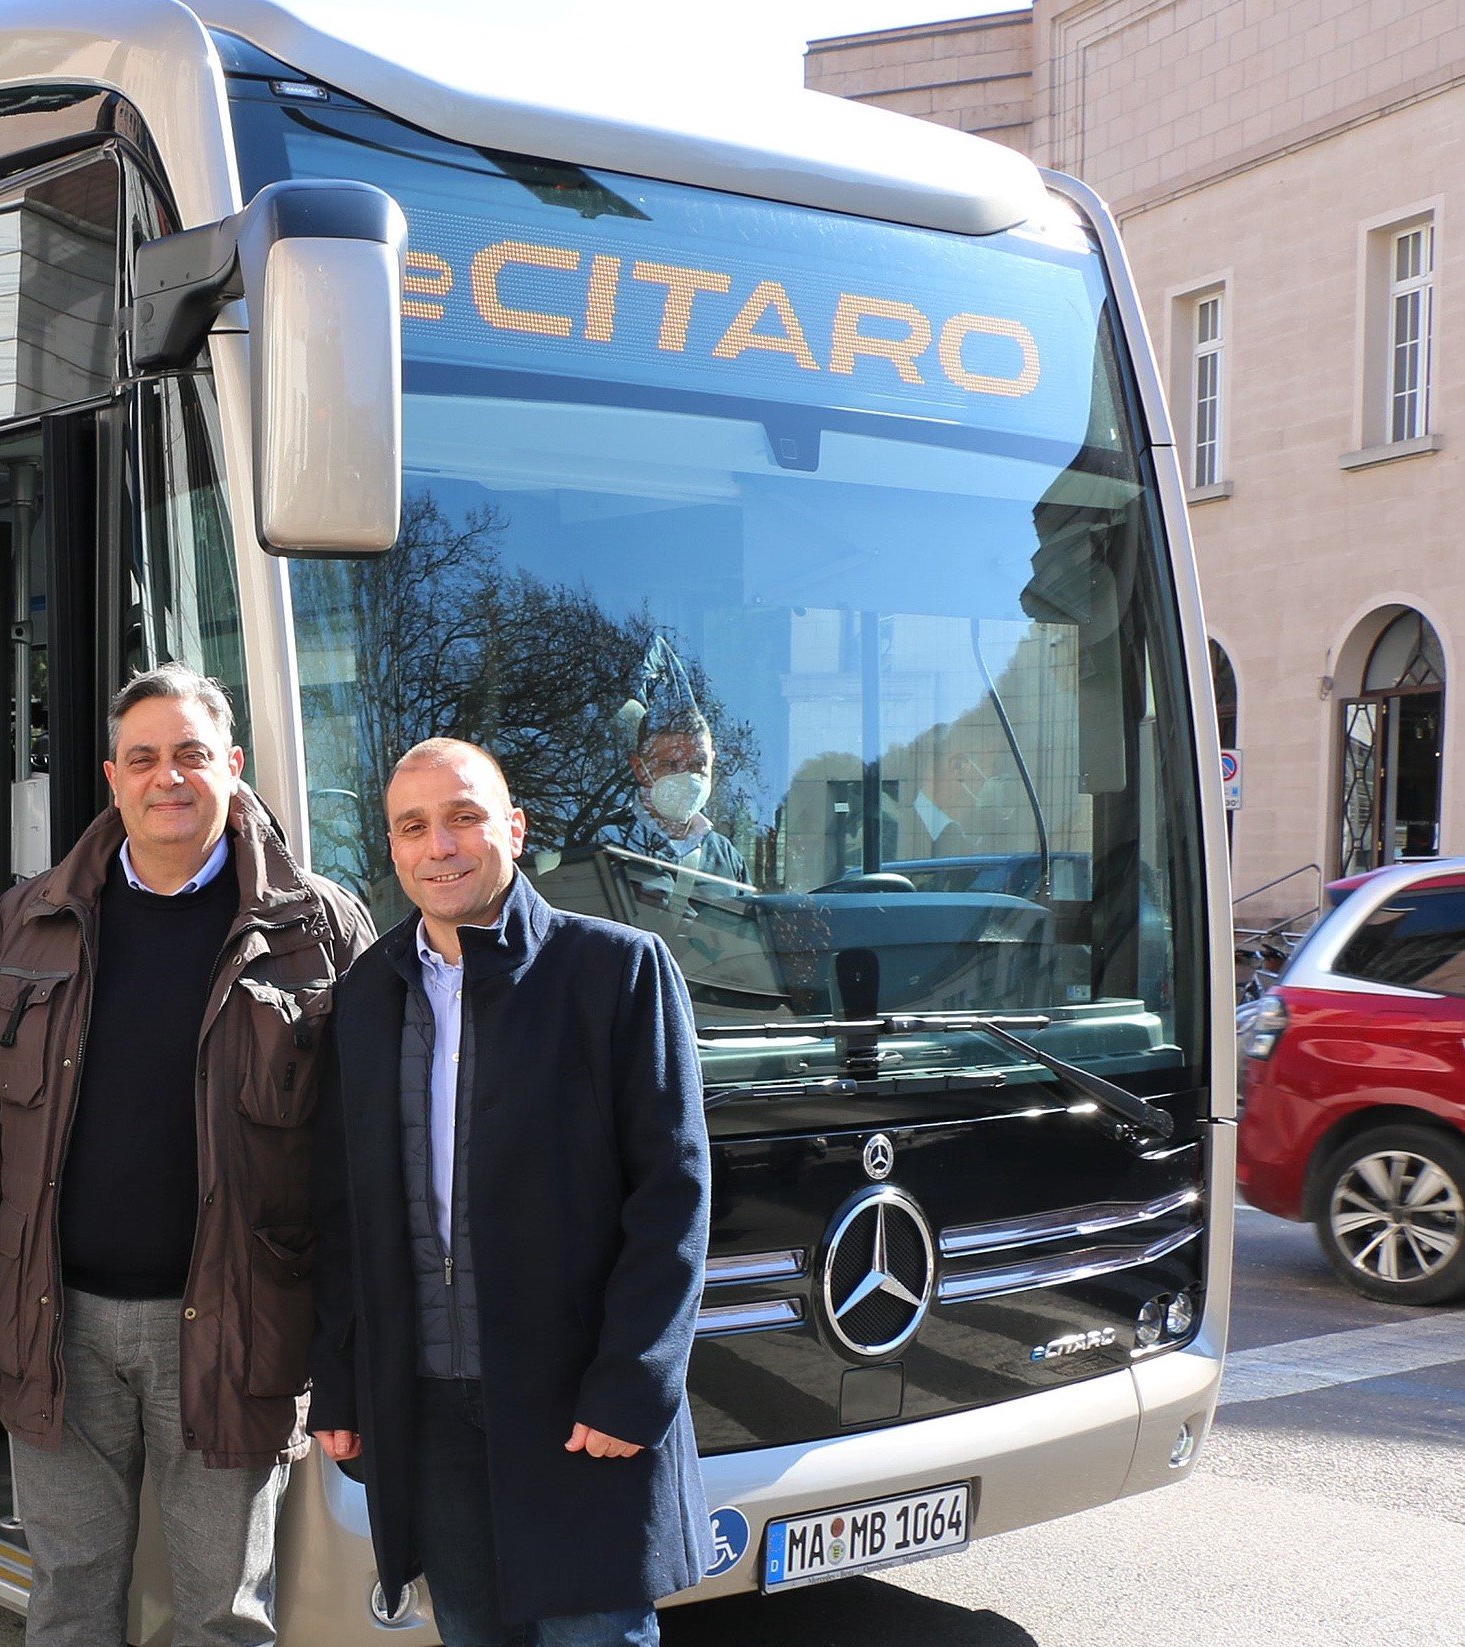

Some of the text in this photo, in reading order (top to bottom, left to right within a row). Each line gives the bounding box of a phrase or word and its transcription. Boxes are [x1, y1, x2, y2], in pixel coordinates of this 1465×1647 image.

[401, 240, 1040, 397] eCITARO
[770, 1560, 779, 1572] D
[788, 1495, 962, 1572] MA MB 1064
